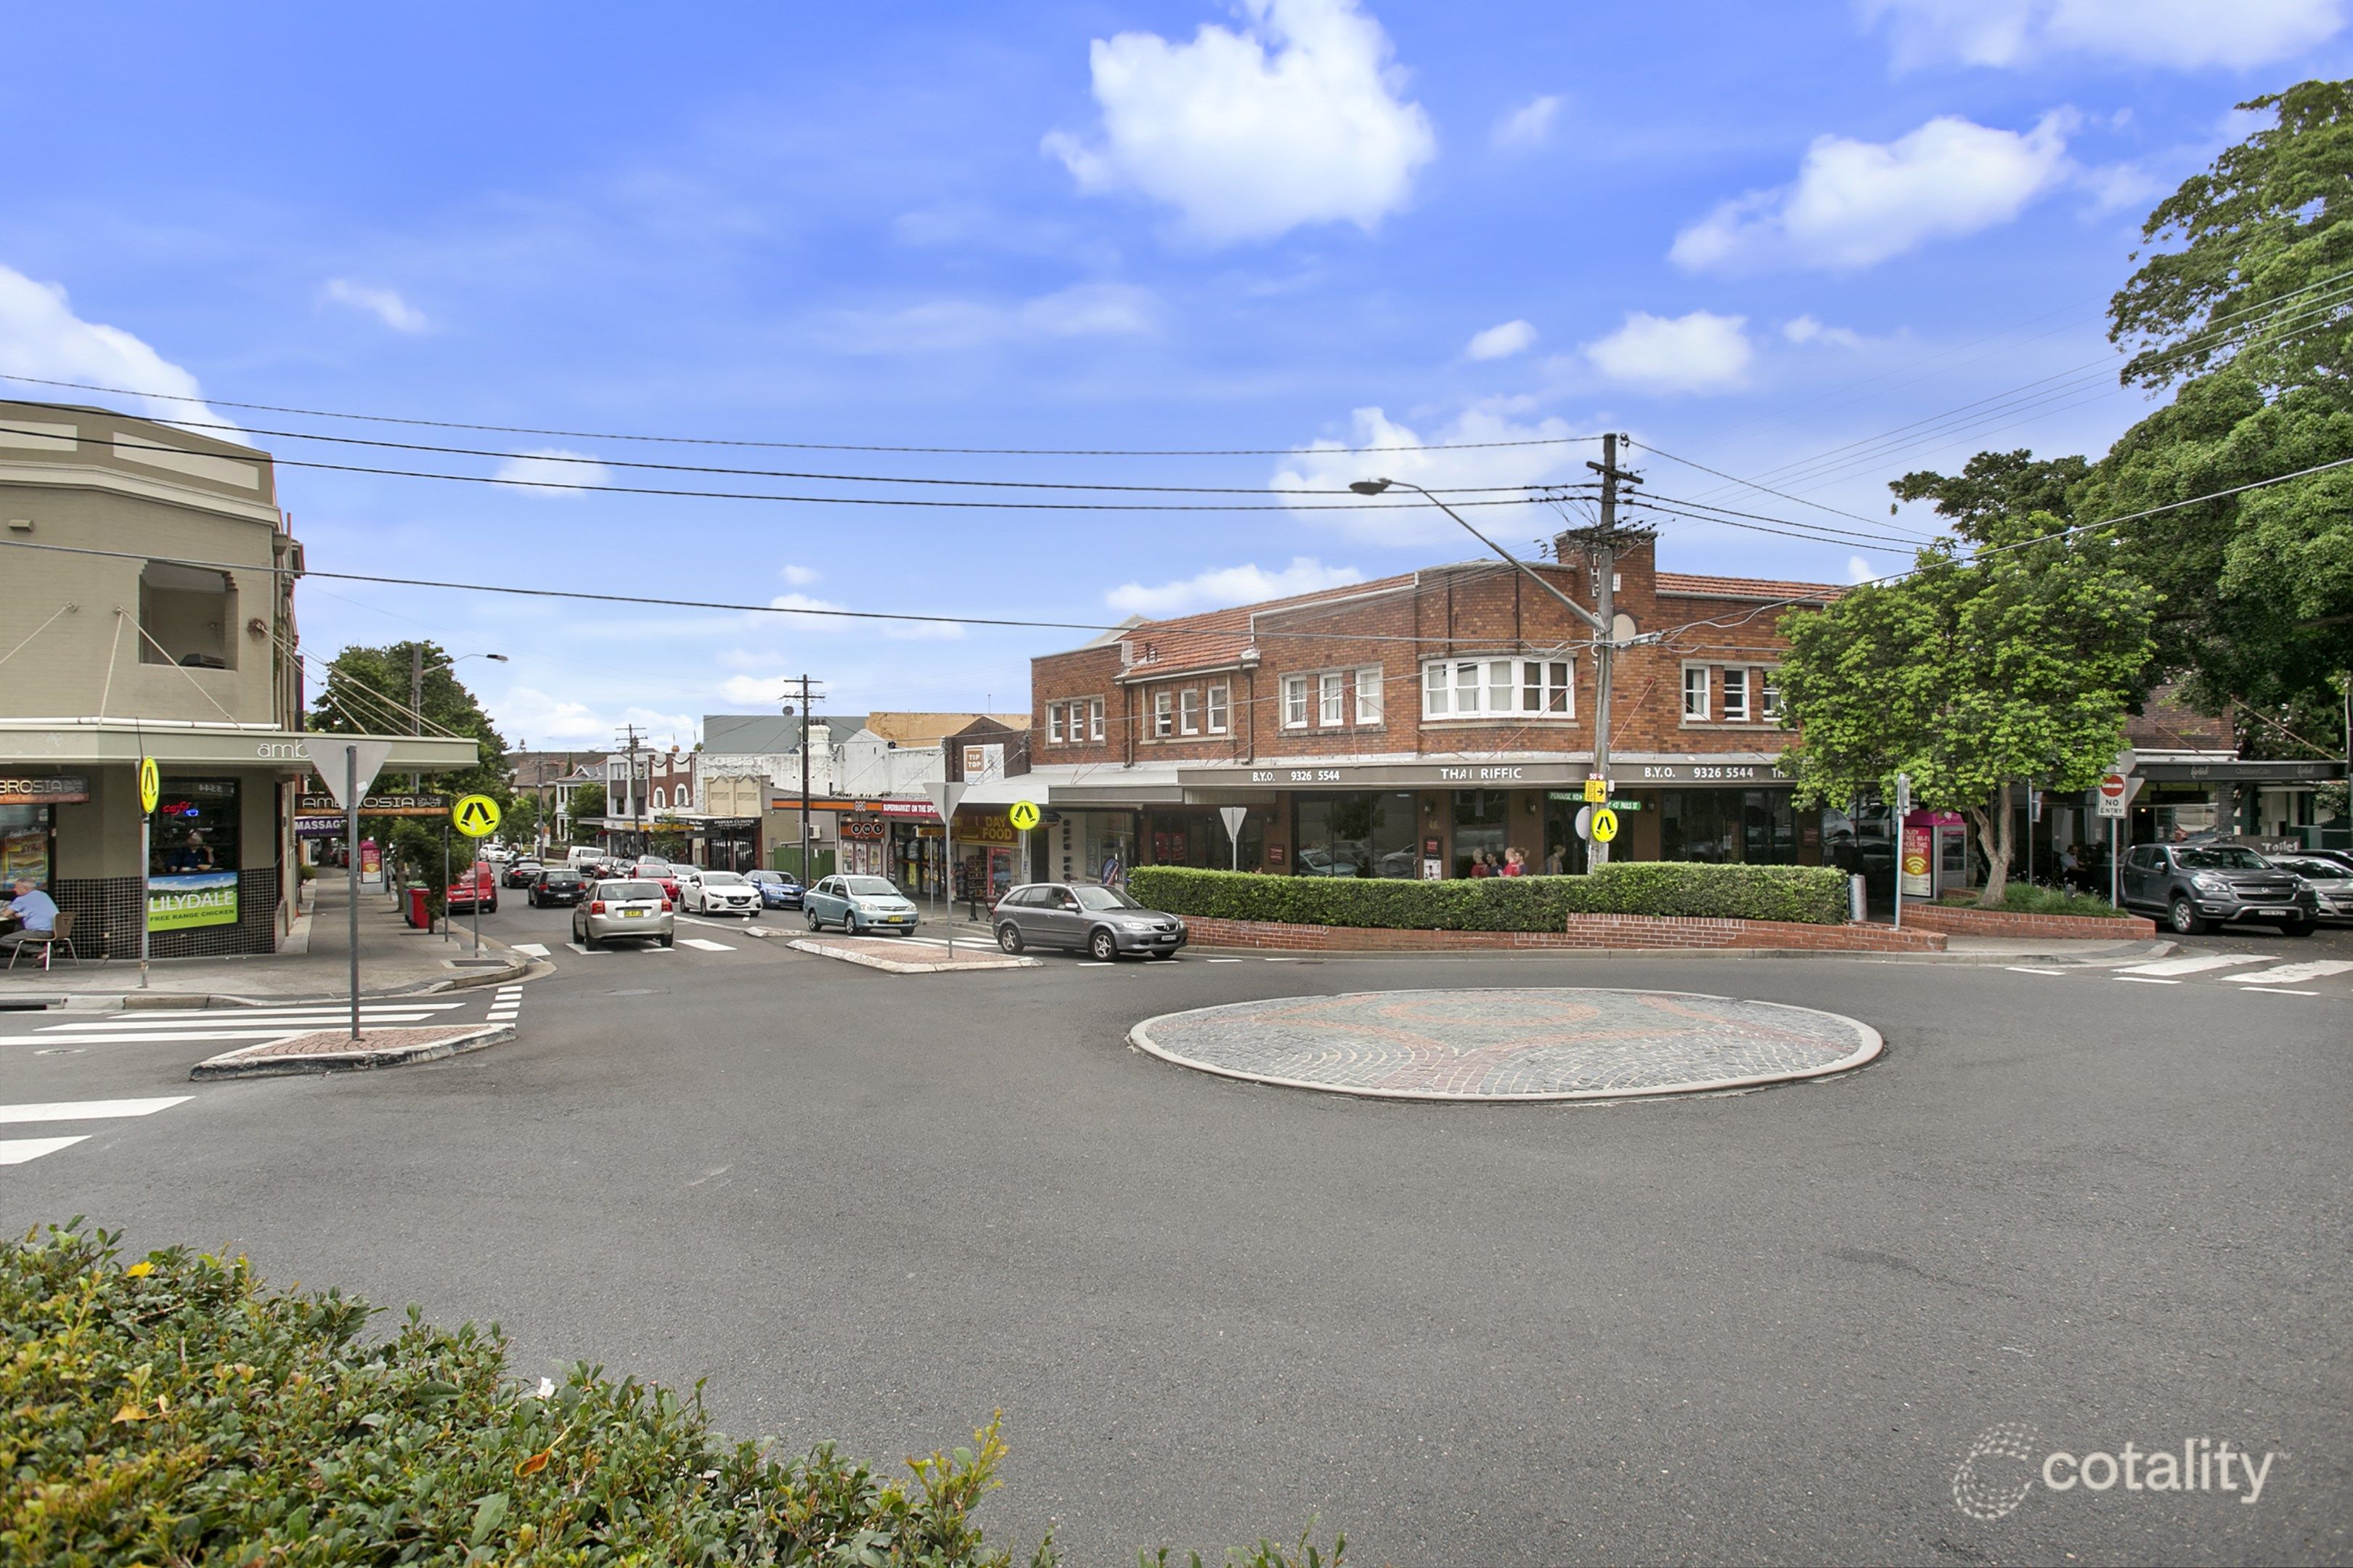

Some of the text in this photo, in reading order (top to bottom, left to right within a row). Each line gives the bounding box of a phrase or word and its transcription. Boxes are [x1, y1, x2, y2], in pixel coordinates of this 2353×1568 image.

[1252, 770, 1340, 782] B.Y.O. 9326 5544
[1440, 767, 1522, 780] THAI RIFFIC
[1644, 767, 1676, 778] B.Y.O.
[1693, 767, 1721, 778] 9326
[1726, 767, 1754, 777] 5544
[302, 797, 415, 809] AMOSIA
[883, 804, 911, 812] SUPERMARKET
[984, 816, 1007, 828] DAY
[982, 828, 1012, 840] FOOD
[2261, 841, 2299, 853] Toilet
[149, 891, 234, 912] LILYDALE
